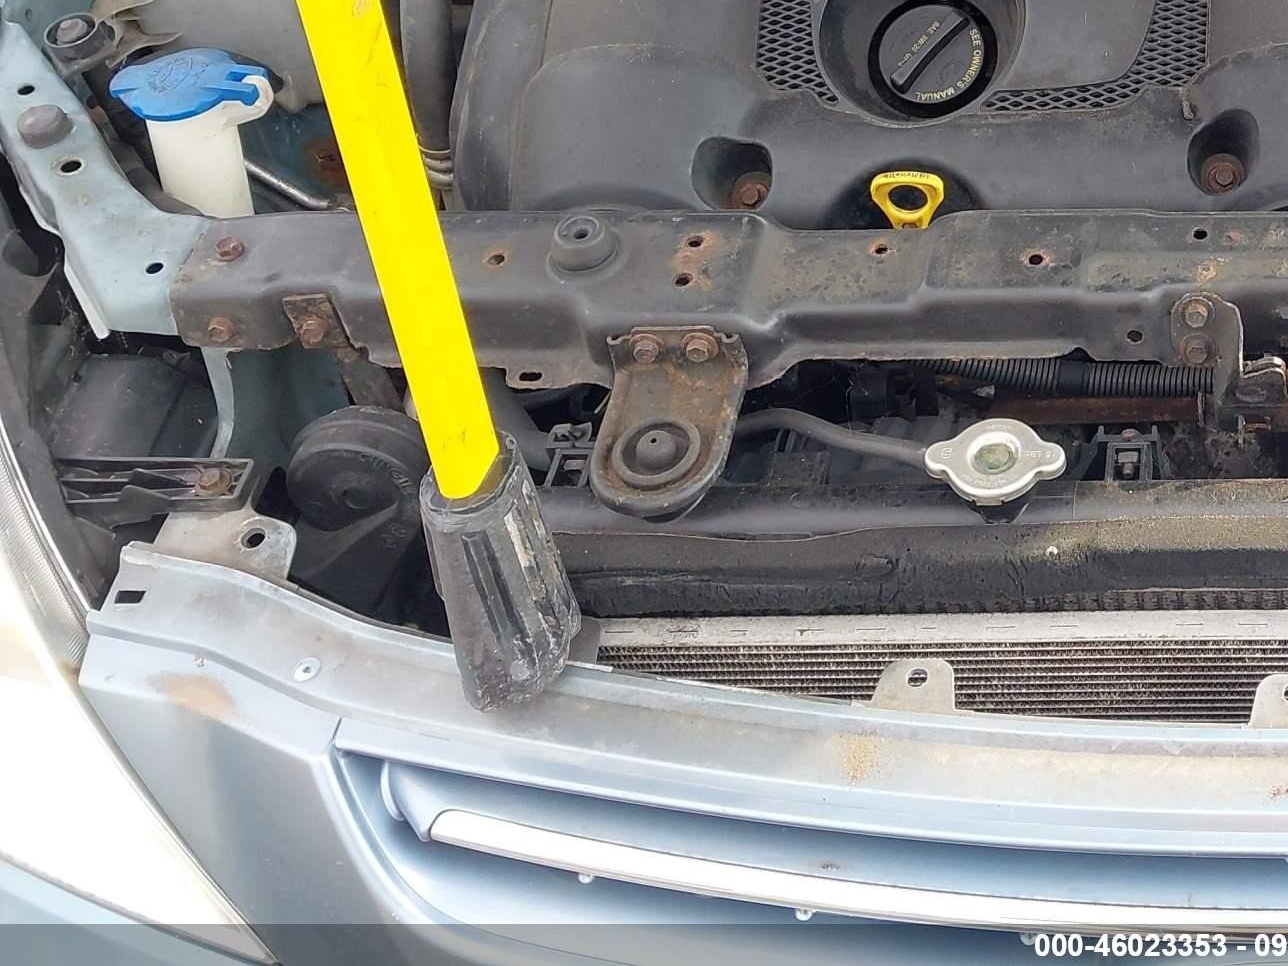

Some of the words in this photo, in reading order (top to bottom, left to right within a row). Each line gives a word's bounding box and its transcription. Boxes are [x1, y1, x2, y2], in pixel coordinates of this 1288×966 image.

[969, 29, 981, 46] SEE
[957, 50, 982, 89] OWNER'S
[915, 86, 956, 101] MANUAL
